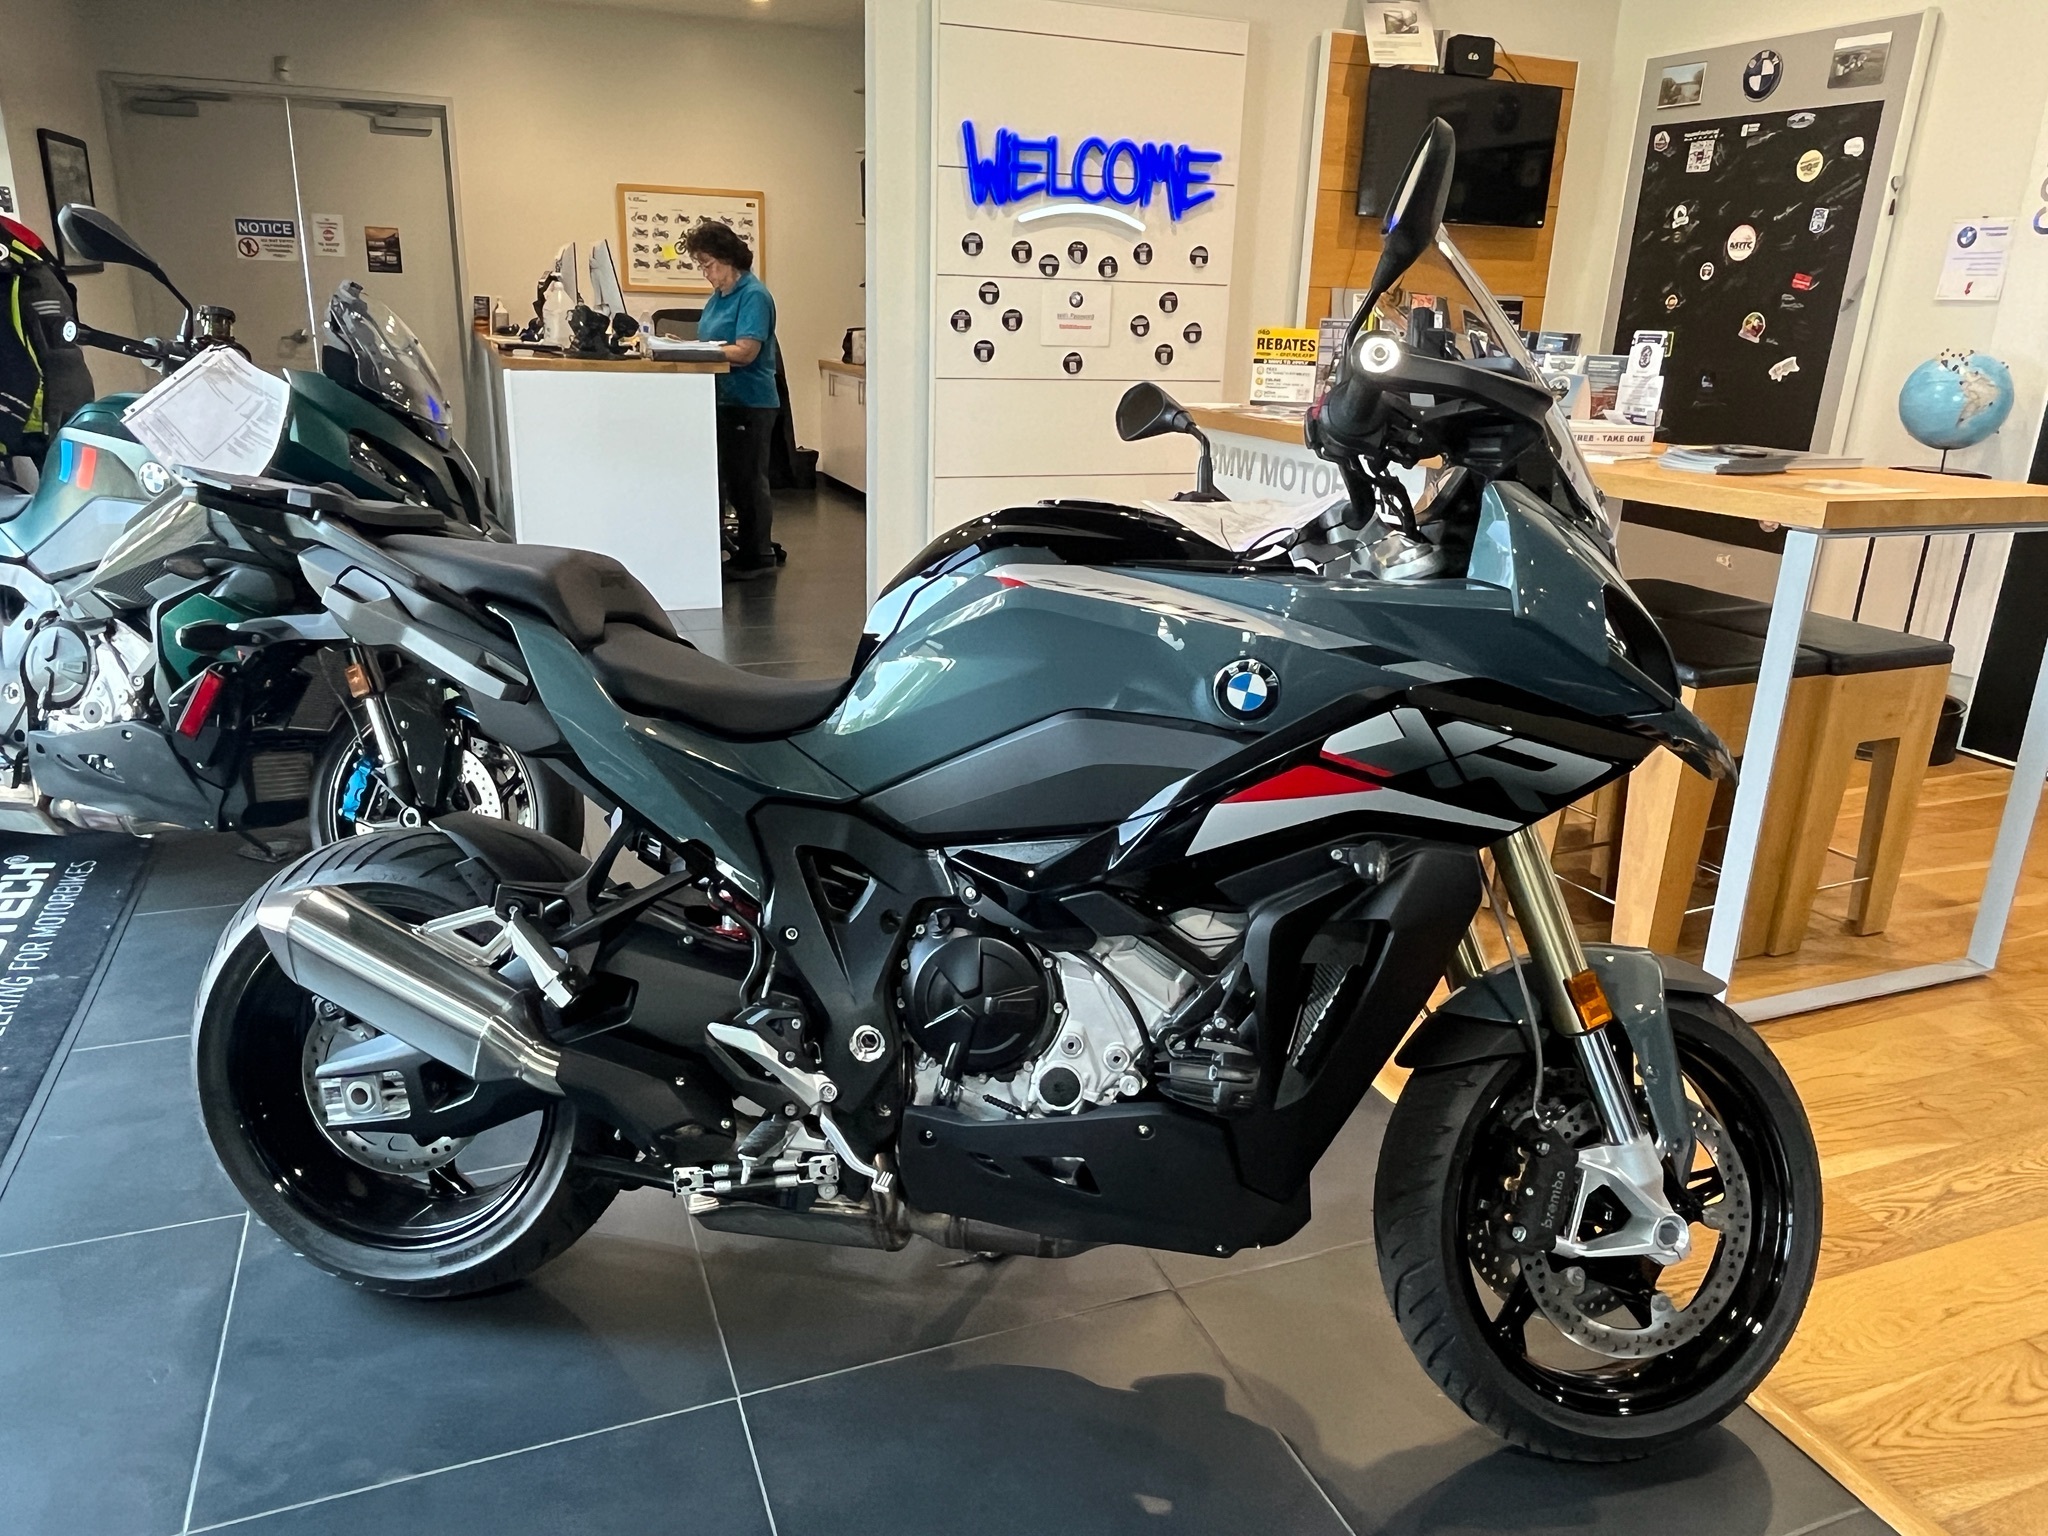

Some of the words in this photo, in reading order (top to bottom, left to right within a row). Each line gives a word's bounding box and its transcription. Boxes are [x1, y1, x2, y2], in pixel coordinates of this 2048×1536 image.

[961, 120, 1223, 221] WELCOME
[237, 221, 293, 236] NOTICE
[1256, 337, 1316, 352] REBATES
[1602, 434, 1625, 443] TAKE
[1627, 435, 1645, 443] ONE
[27, 860, 97, 938] MOTORBIKES
[8, 941, 53, 971] FOR
[1541, 1170, 1566, 1229] brembo
